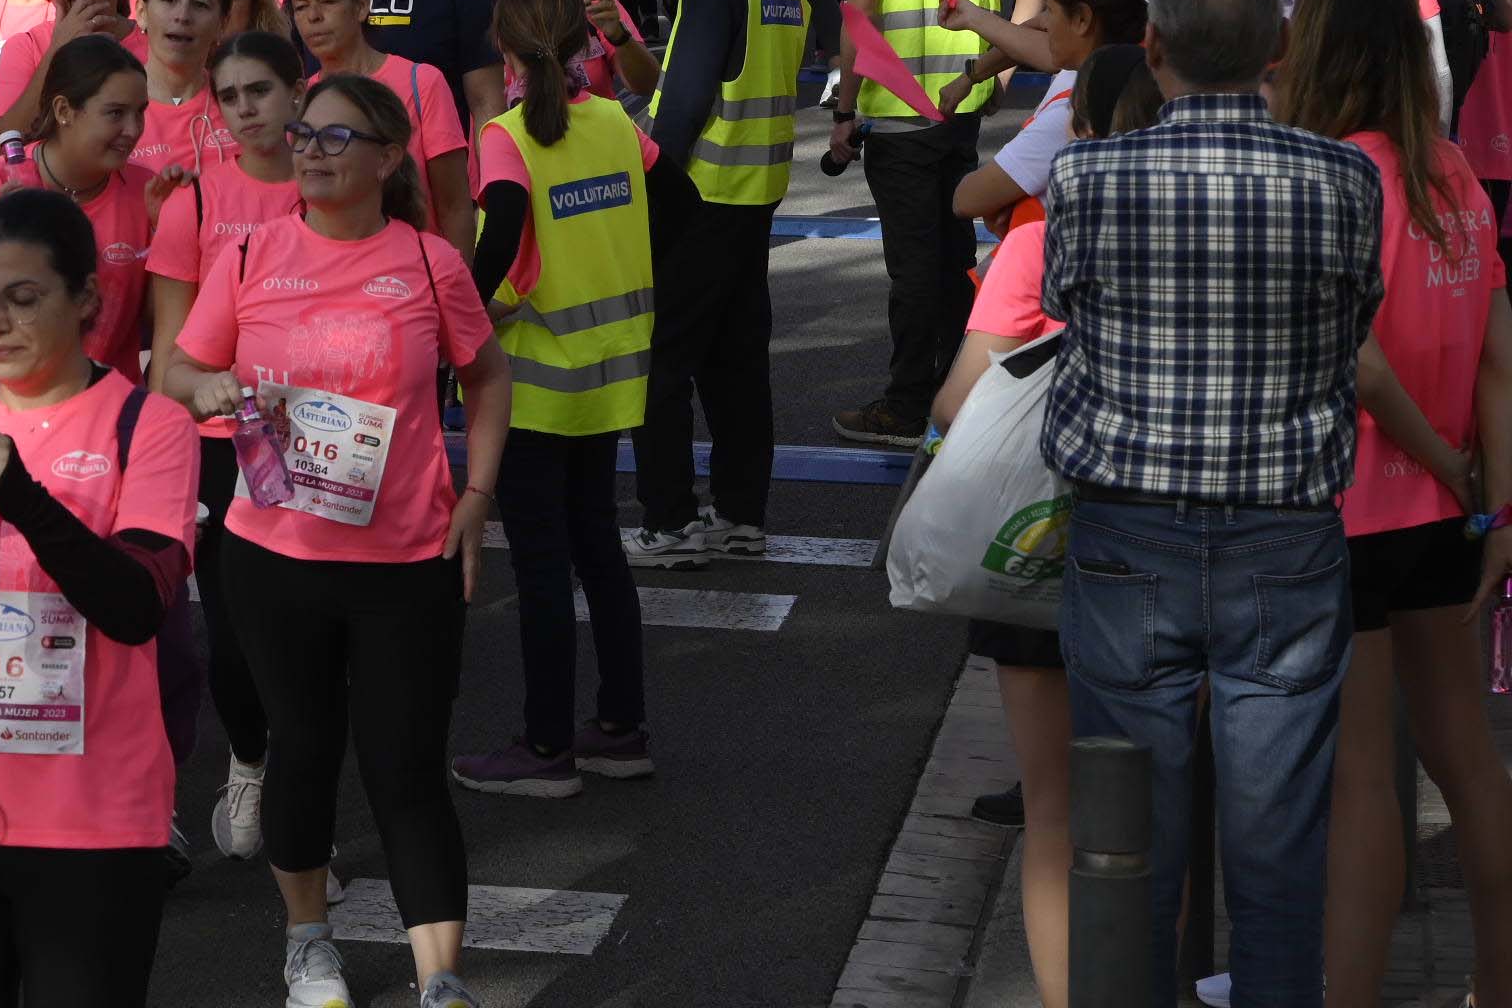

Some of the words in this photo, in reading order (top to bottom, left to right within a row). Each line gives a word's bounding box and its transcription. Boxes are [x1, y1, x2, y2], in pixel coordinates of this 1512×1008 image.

[262, 277, 319, 291] OYSHO
[298, 407, 347, 429] ASTURIANA
[357, 417, 384, 430] SUMA
[293, 435, 339, 461] 016
[294, 458, 329, 475] 10384
[294, 474, 305, 484] DE
[322, 498, 363, 516] Santander
[41, 615, 75, 626] SUMA
[4, 707, 39, 717] MUJER
[43, 709, 66, 718] 2023
[15, 729, 71, 742] Santander
